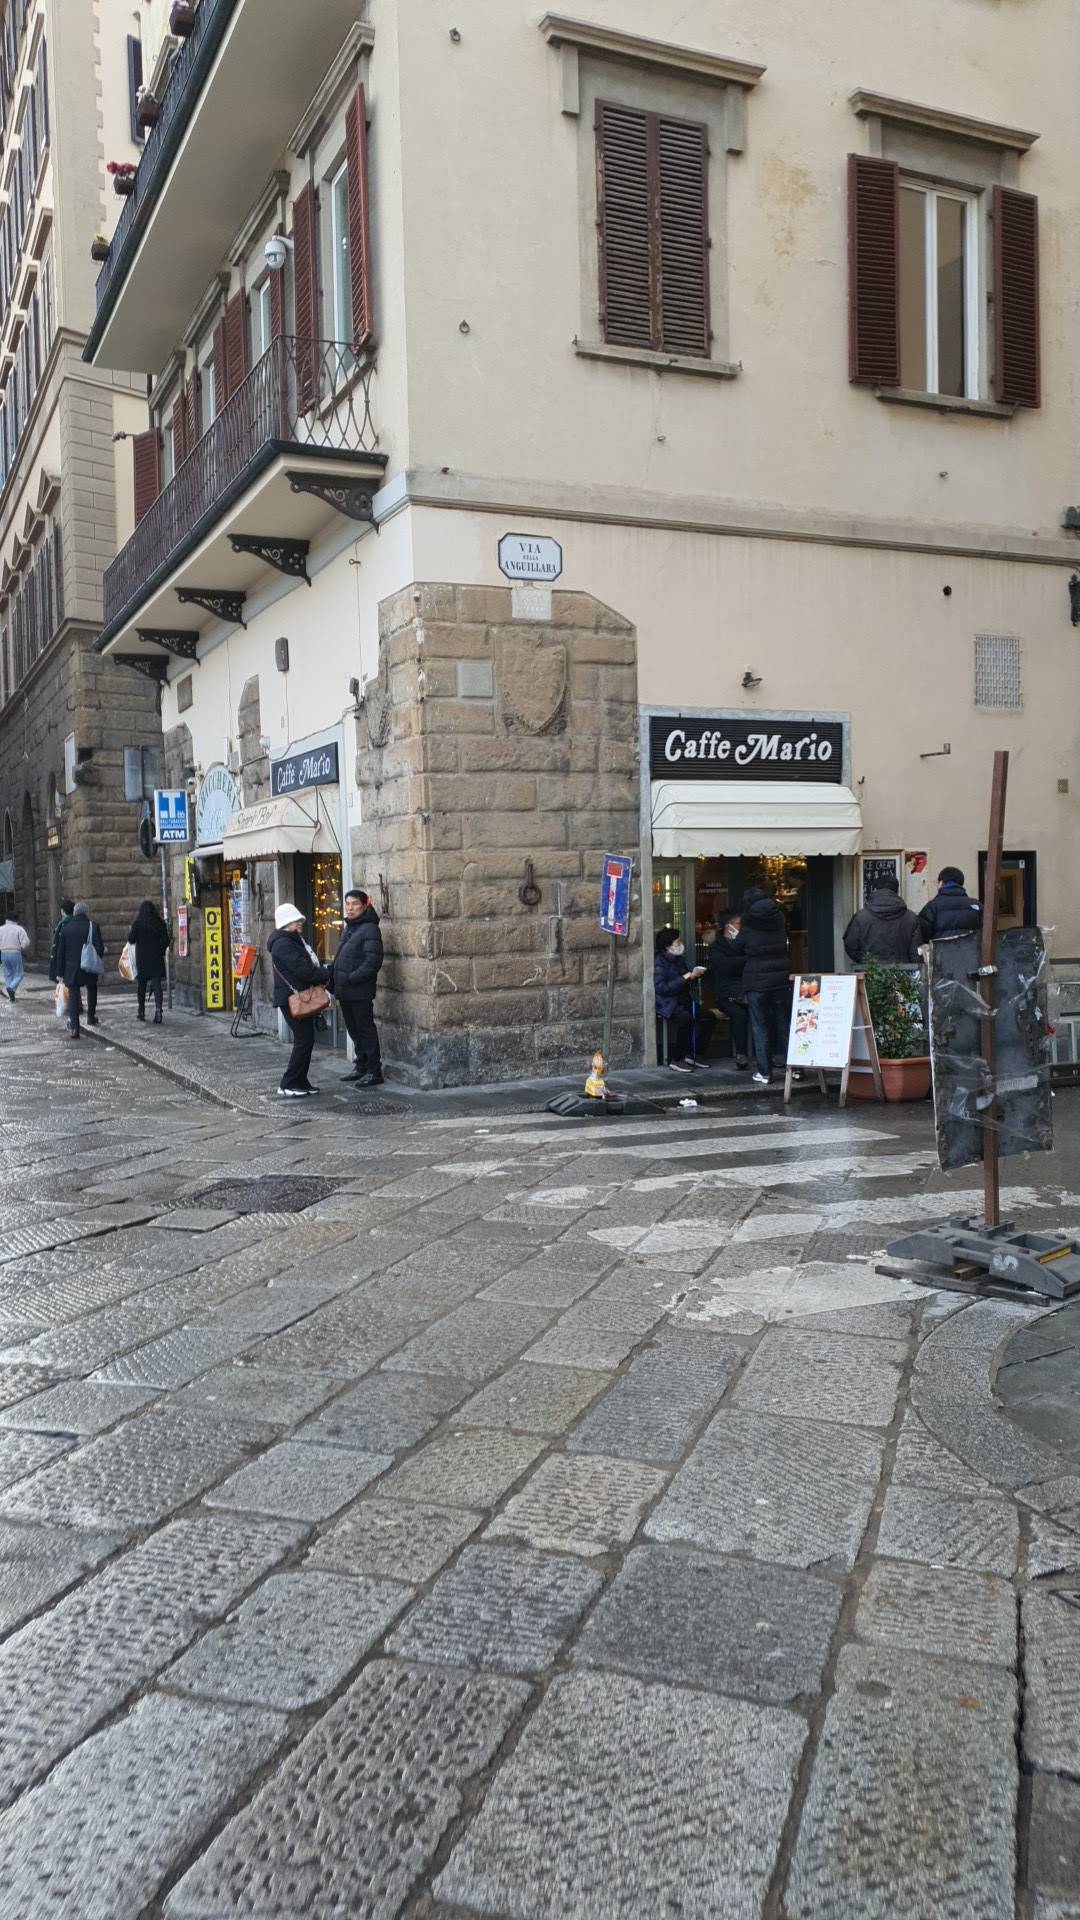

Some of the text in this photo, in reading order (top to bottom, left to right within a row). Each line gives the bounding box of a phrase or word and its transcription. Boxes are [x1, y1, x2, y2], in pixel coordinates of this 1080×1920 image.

[519, 542, 541, 554] VIA
[503, 560, 557, 574] ANGUILLARA
[734, 733, 833, 765] Mario
[299, 752, 331, 786] Mario
[163, 830, 185, 839] ATM
[210, 932, 220, 1004] CHANGE
